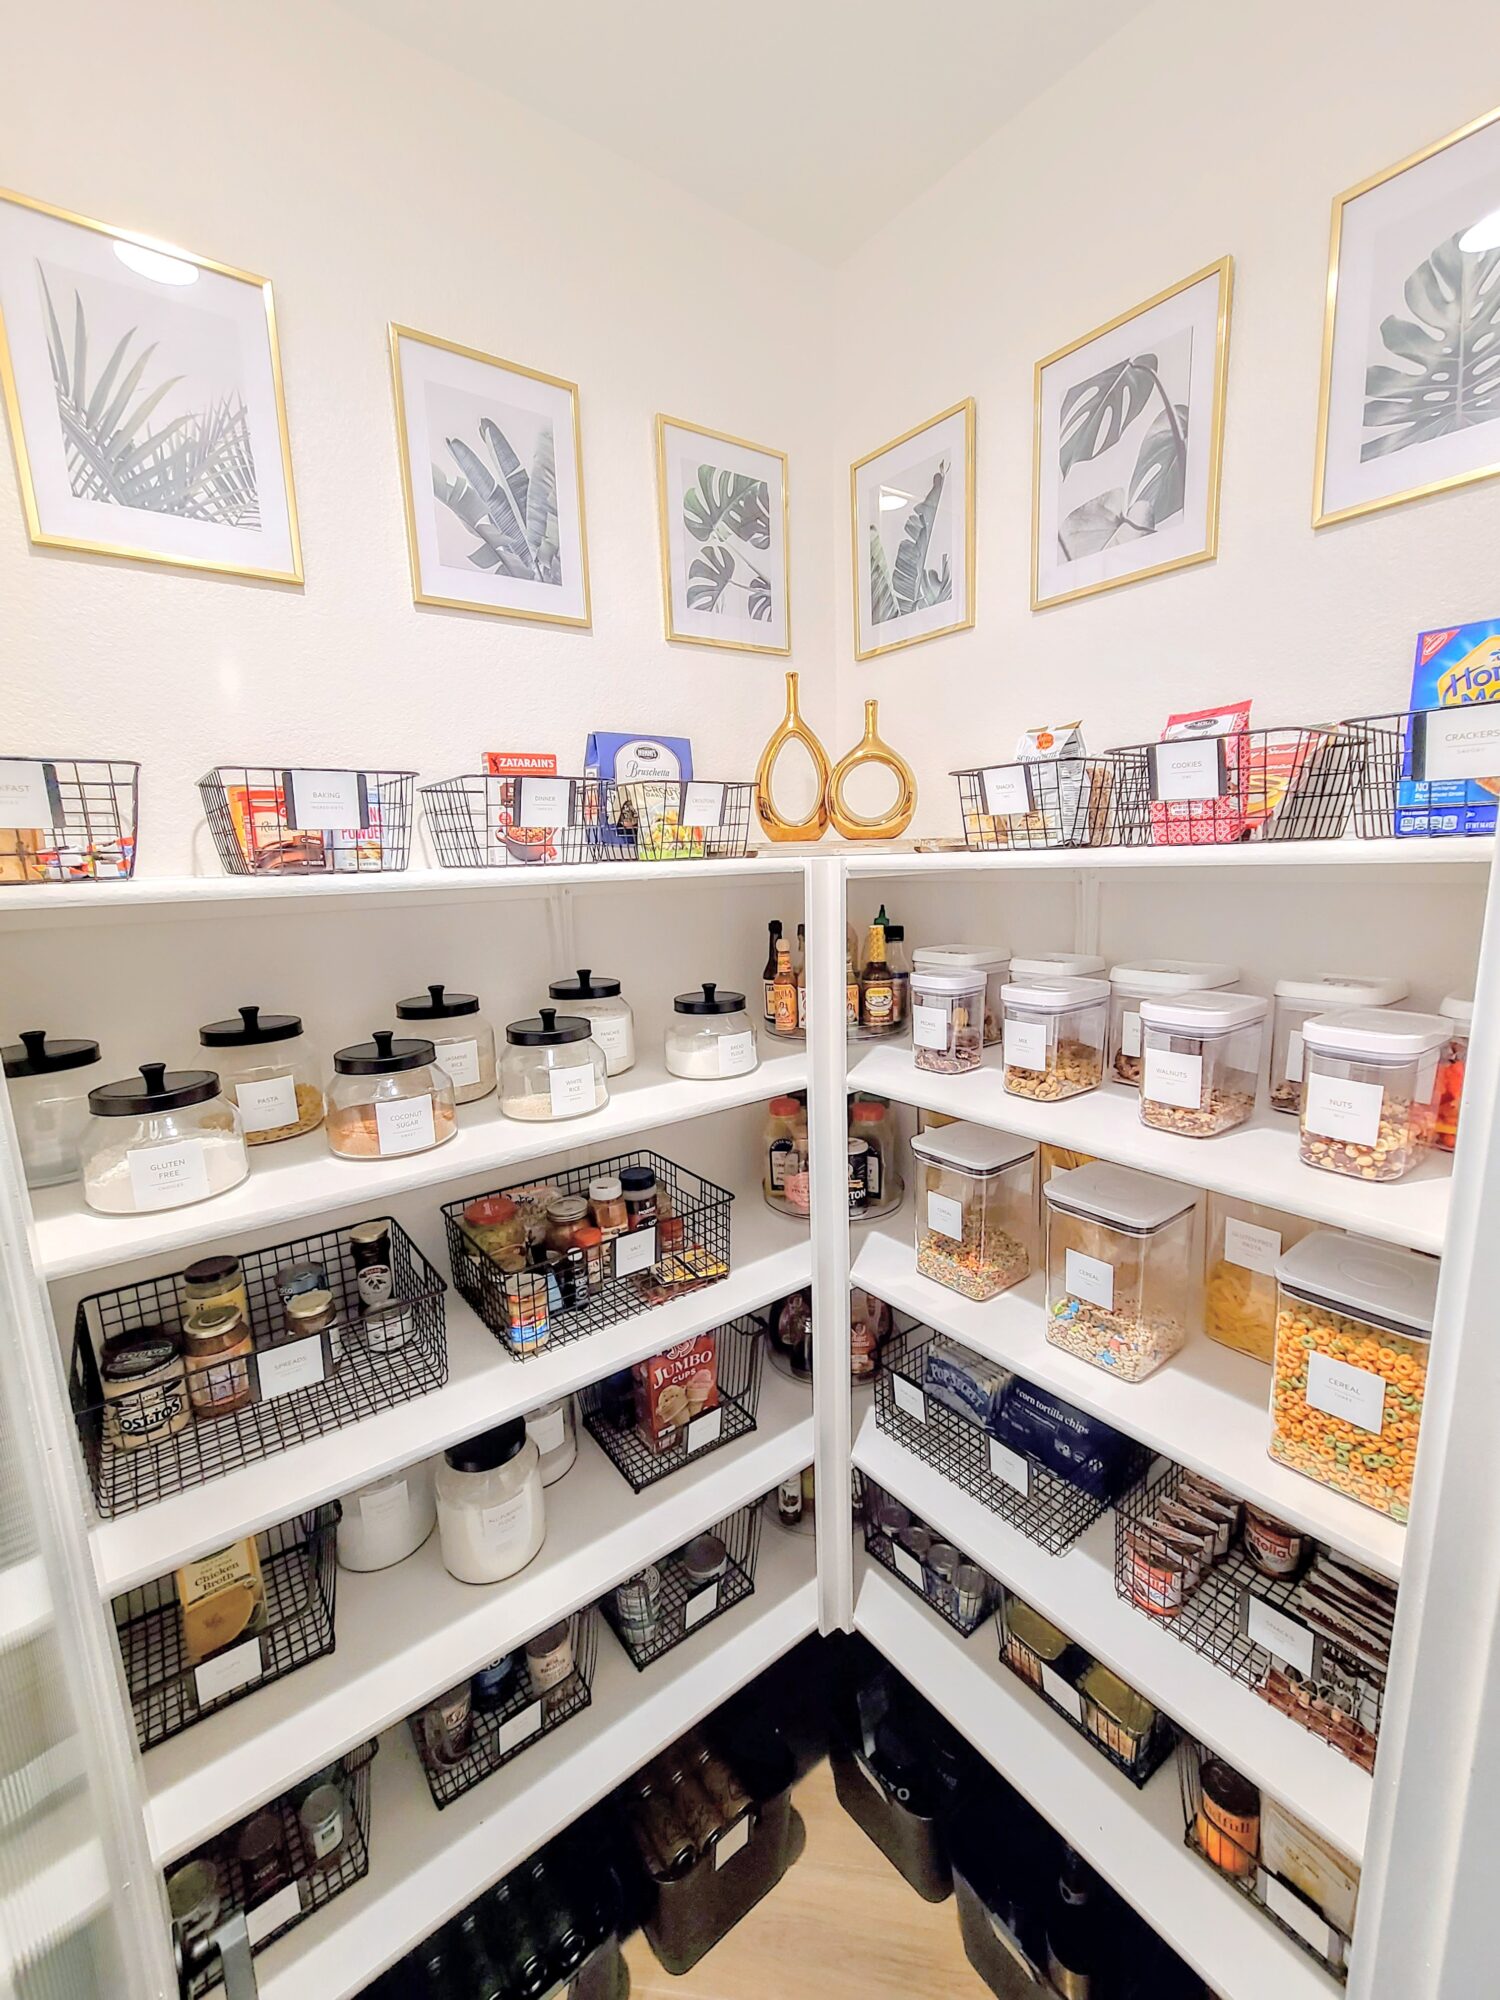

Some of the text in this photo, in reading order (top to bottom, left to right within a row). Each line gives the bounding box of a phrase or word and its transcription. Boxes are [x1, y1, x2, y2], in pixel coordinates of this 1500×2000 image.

[1445, 730, 1500, 742] CRACKERS
[625, 759, 670, 779] Bruschetta
[1171, 761, 1203, 770] COOKIES
[1156, 1067, 1189, 1079] WALNUTS
[257, 1095, 280, 1105] PASTA
[1329, 1098, 1353, 1110] NUTS
[390, 1110, 423, 1122] COCONUT
[395, 1119, 420, 1129] SUGAR
[150, 1158, 186, 1171] GLUTEN
[158, 1169, 181, 1180] FREE
[1079, 1268, 1100, 1282] CEREAL
[653, 1350, 713, 1390] JUMBO
[671, 1368, 697, 1384] CUPS
[1328, 1377, 1361, 1396] CEREAL
[1018, 1391, 1090, 1438] corn tortilla chips
[194, 1561, 240, 1588] Chicken
[203, 1573, 235, 1592] Broth
